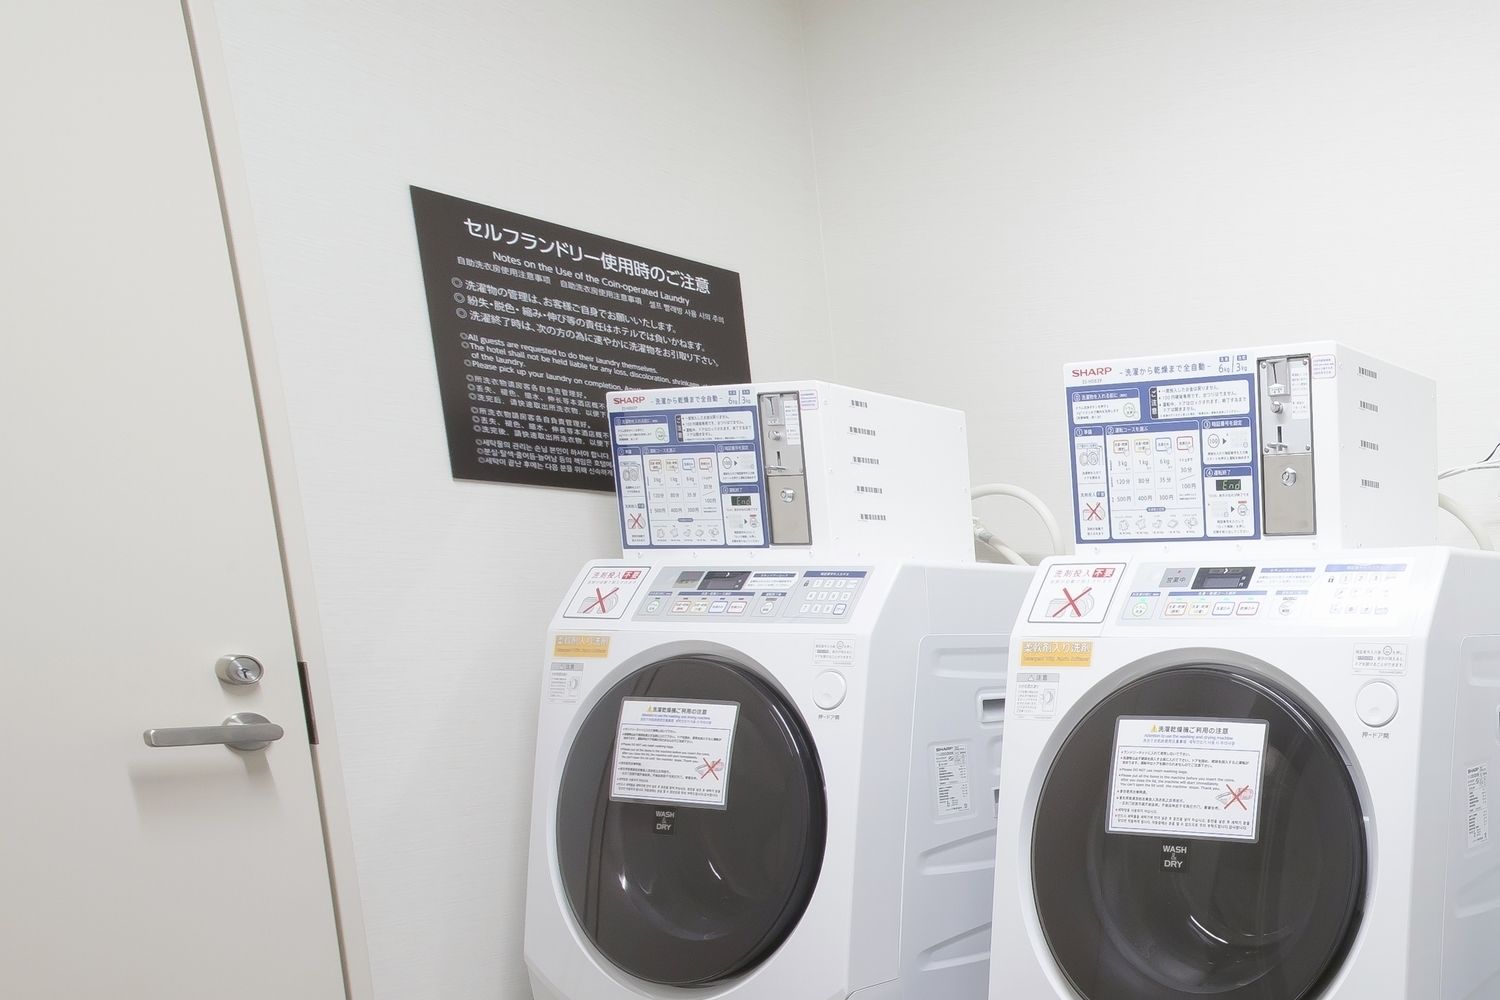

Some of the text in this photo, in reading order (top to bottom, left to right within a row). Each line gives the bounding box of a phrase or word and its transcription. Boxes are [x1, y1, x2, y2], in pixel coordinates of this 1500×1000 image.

[464, 218, 710, 294] セルフランドリー使用時のご注意
[492, 251, 690, 306] Notes on the Use of the Coin-operated Laundry
[470, 342, 485, 352] The
[486, 346, 506, 356] hotel
[508, 350, 525, 359] shall
[540, 355, 550, 363] be
[480, 336, 505, 346] guests
[520, 344, 557, 356] requested
[558, 350, 566, 358] to
[568, 352, 578, 360] do
[579, 353, 594, 362] their
[596, 356, 620, 368] laundry
[480, 354, 494, 362] the
[472, 360, 498, 371] Please
[499, 366, 515, 374] pick
[528, 370, 544, 378] your
[546, 372, 572, 384] laundry
[1072, 367, 1112, 378] SHARP
[614, 397, 645, 405] SHARP
[1163, 845, 1187, 853] WASH
[1164, 860, 1183, 868] DRY
